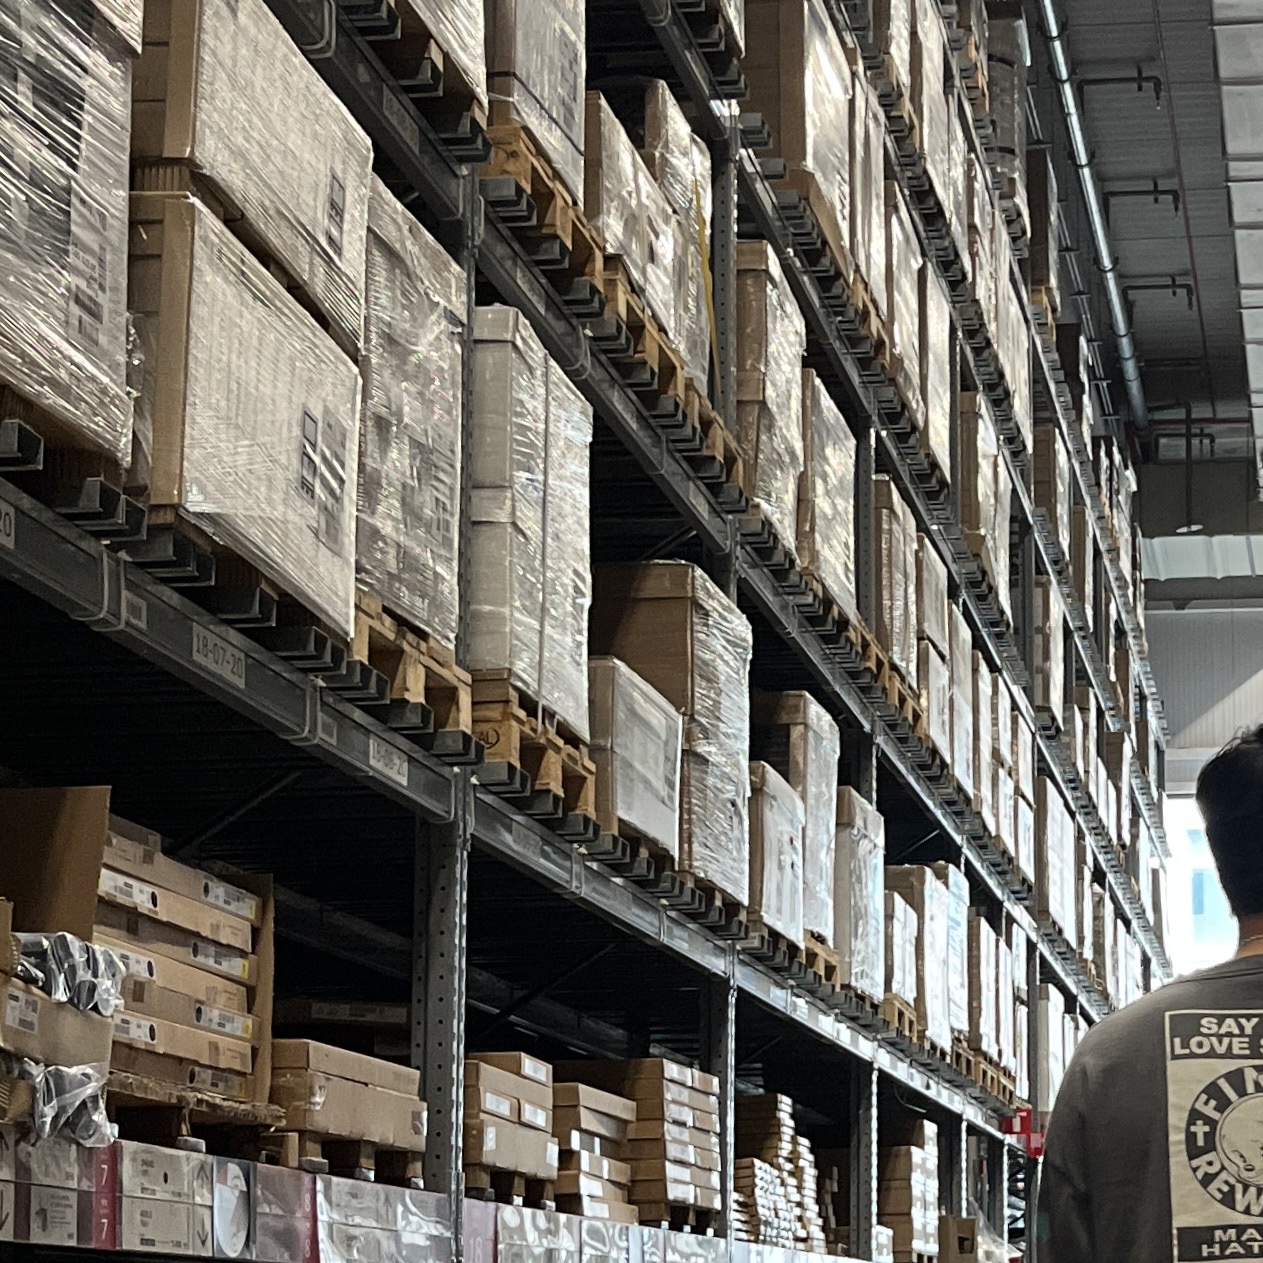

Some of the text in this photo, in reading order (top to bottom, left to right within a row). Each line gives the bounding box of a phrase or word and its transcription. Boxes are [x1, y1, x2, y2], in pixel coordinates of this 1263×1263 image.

[194, 633, 244, 680] 18-07-20
[1200, 1017, 1259, 1035] SAY
[1173, 1036, 1251, 1056] LOVE
[100, 1164, 109, 1185] 7
[101, 1218, 109, 1240] 7
